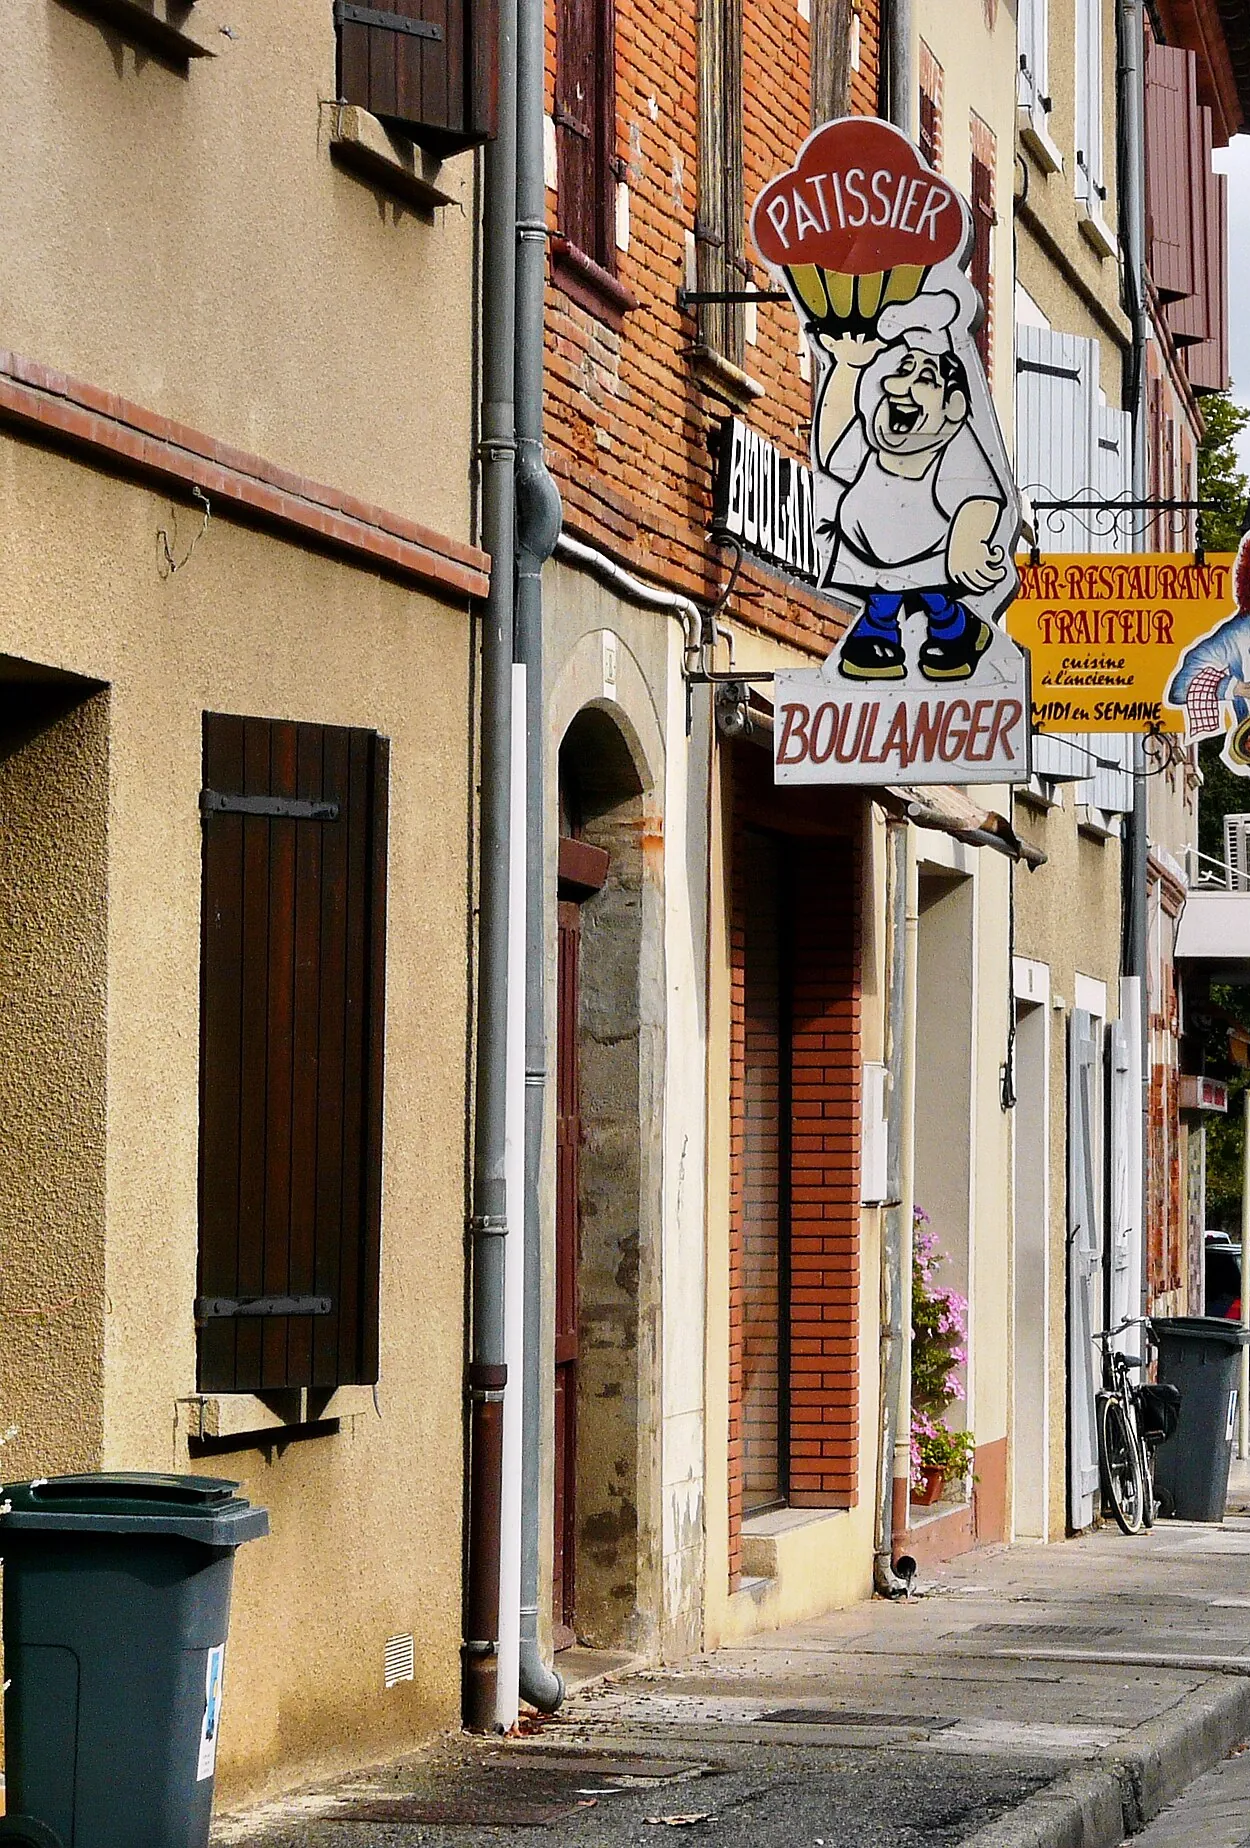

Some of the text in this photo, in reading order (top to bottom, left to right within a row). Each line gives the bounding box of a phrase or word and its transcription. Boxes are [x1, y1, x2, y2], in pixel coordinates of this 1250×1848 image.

[766, 168, 951, 249] PATISSIER
[1037, 608, 1175, 645] TRAITEUR
[1061, 653, 1126, 670] cuisine
[1053, 670, 1135, 686] l'ancienne
[1031, 702, 1163, 721] MIDI en SEMAINE
[776, 699, 1022, 768] BOULANGER
